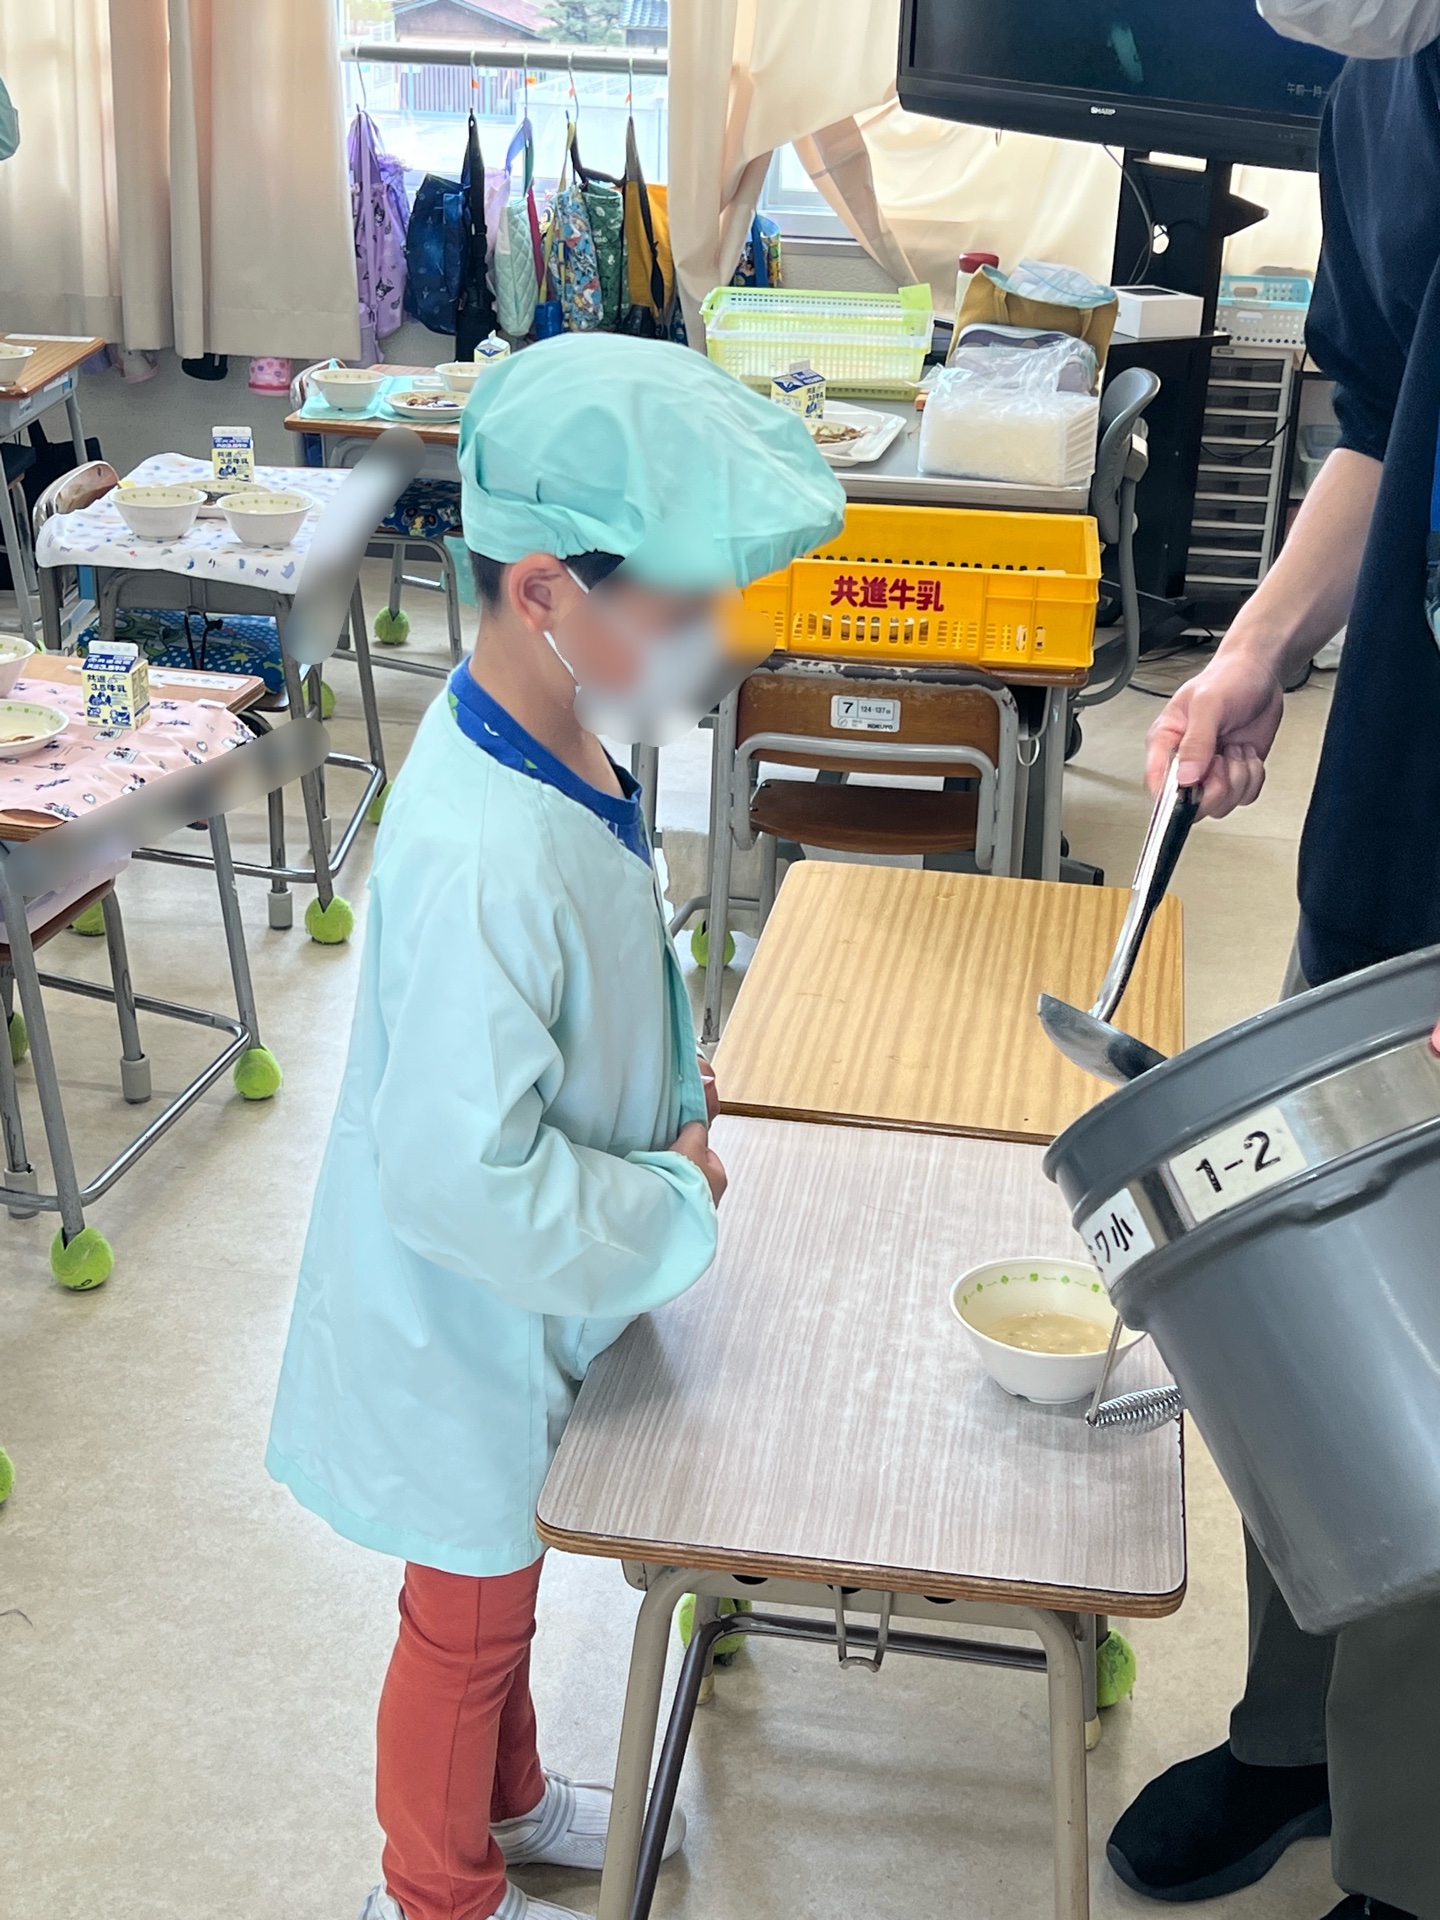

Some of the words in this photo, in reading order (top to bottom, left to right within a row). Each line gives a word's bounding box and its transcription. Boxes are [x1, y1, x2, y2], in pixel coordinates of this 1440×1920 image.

[1090, 105, 1116, 116] SHARP
[830, 574, 944, 611] 共進牛乳
[91, 683, 127, 692] 3.5牛乳
[843, 702, 854, 714] 7
[1195, 1130, 1282, 1193] 1-2
